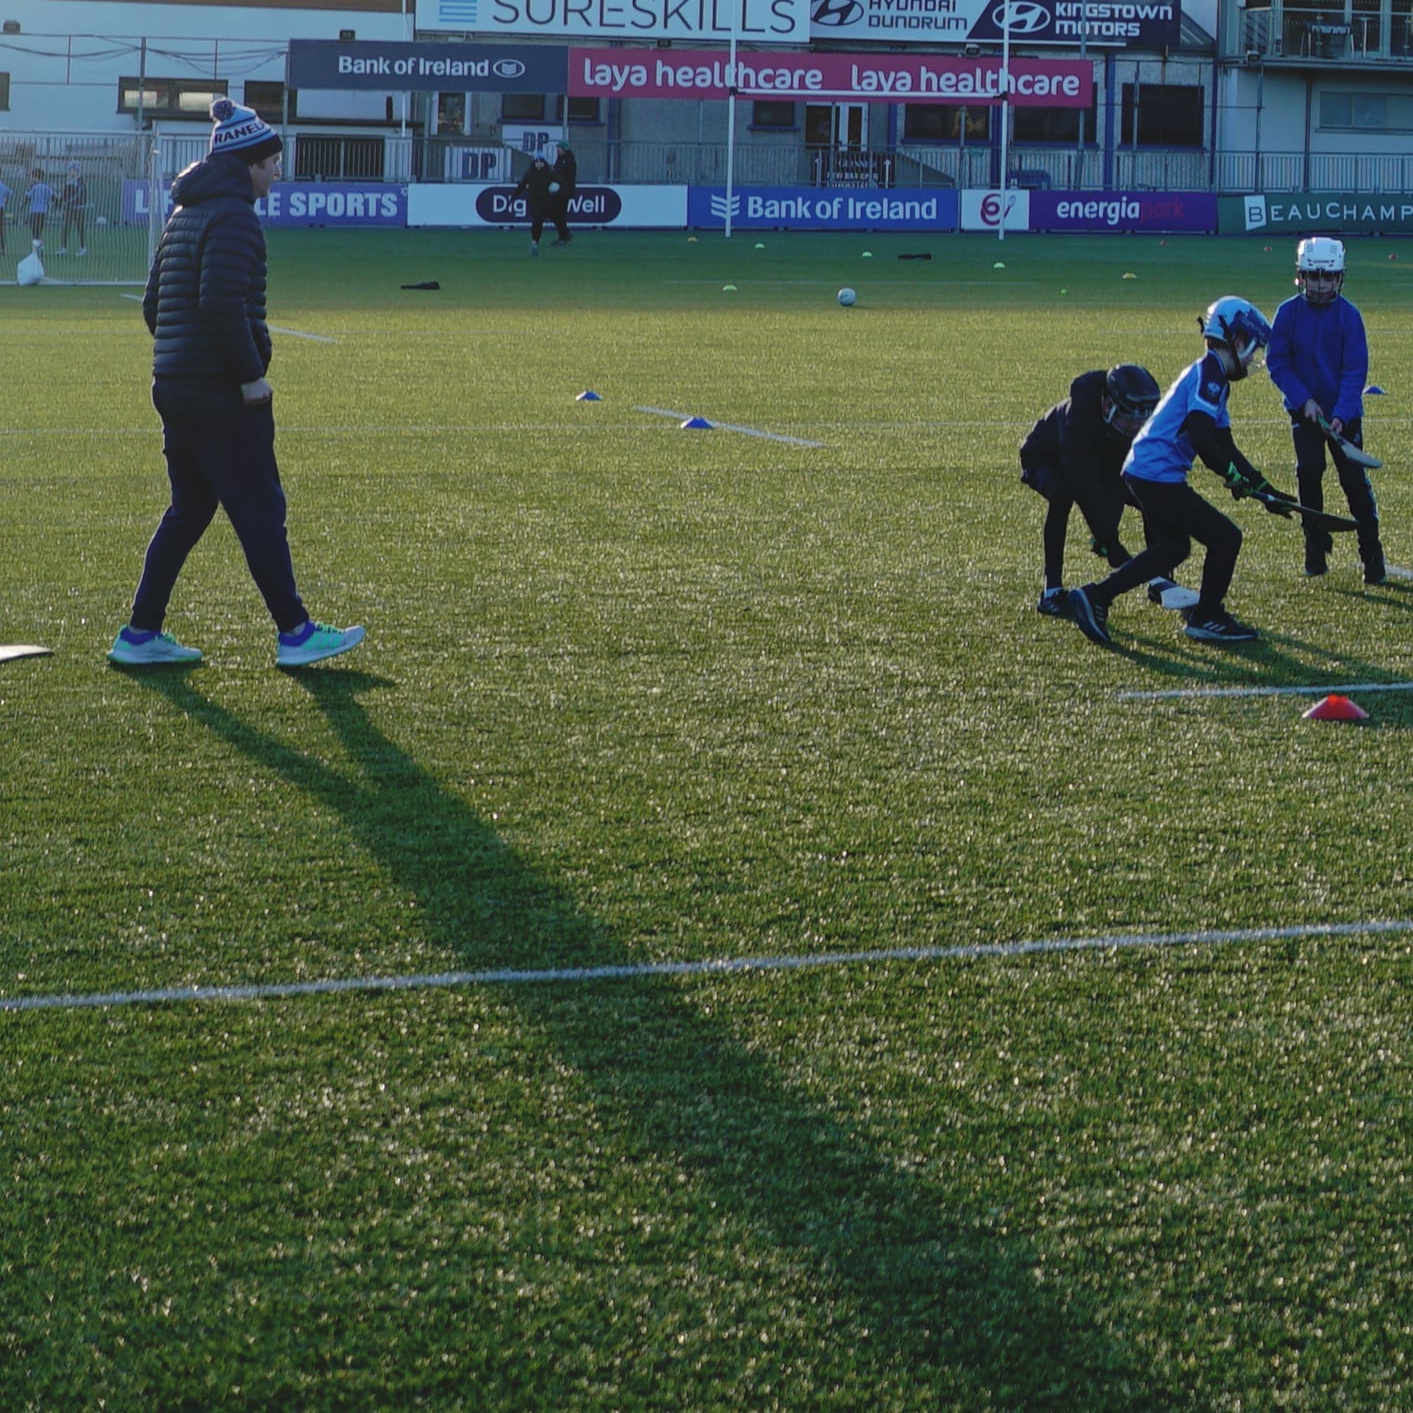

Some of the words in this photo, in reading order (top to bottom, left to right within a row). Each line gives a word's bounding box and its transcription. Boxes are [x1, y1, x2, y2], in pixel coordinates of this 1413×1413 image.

[868, 14, 968, 30] DUNDRUM
[1055, 2, 1173, 21] KINGSTOWN
[1055, 21, 1141, 37] MOTORS
[338, 55, 391, 74] Bank
[394, 56, 416, 75] of
[419, 57, 489, 77] Ireland
[584, 57, 648, 91] laya
[655, 59, 823, 91] healthcare
[852, 64, 911, 94] laya
[920, 66, 1080, 96] healthcare
[461, 152, 497, 179] DP
[288, 192, 399, 218] SPORTS
[747, 195, 812, 219] Bank
[815, 196, 844, 220] of
[848, 197, 937, 220] Ireland
